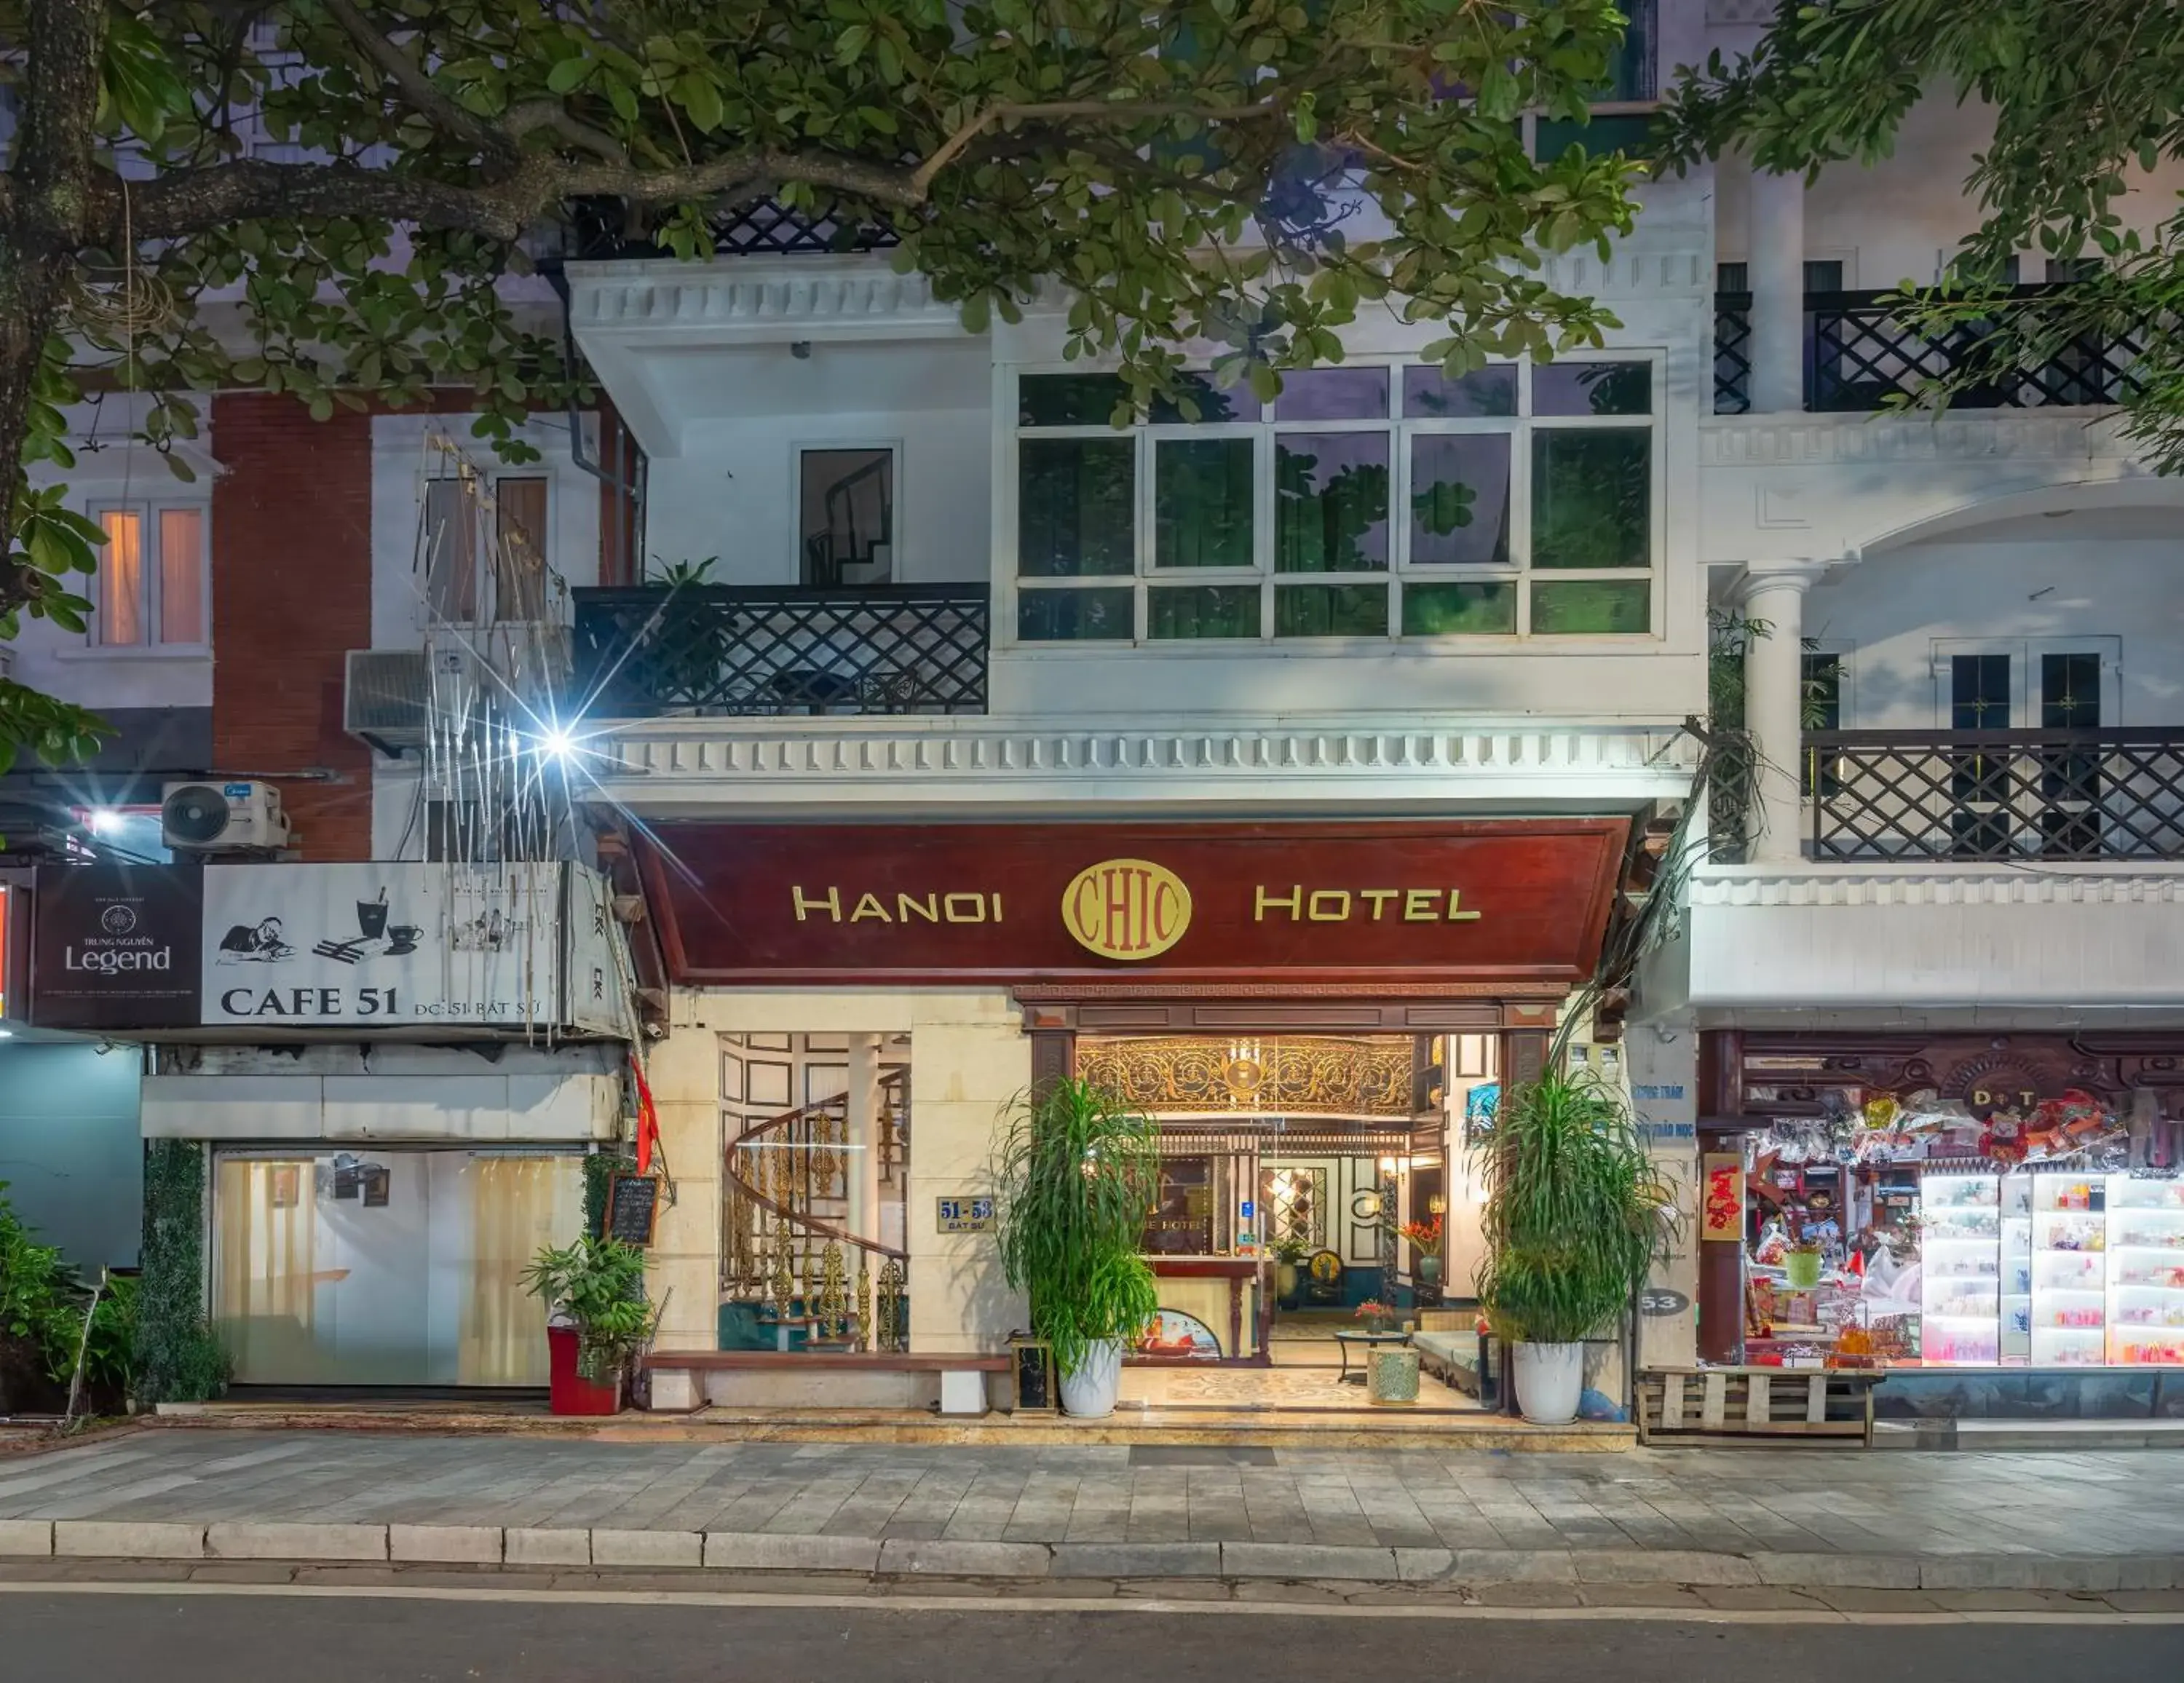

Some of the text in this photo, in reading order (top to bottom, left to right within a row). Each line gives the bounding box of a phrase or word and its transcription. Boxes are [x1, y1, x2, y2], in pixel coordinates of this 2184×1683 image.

[792, 885, 1002, 922] HANOI
[1254, 884, 1481, 921] HOTEL
[66, 946, 170, 975] Legend
[221, 987, 400, 1015] CAFE 51
[1974, 1090, 2035, 1106] D T
[1162, 1219, 1202, 1230] HOTEL
[1642, 1296, 1677, 1310] 53
